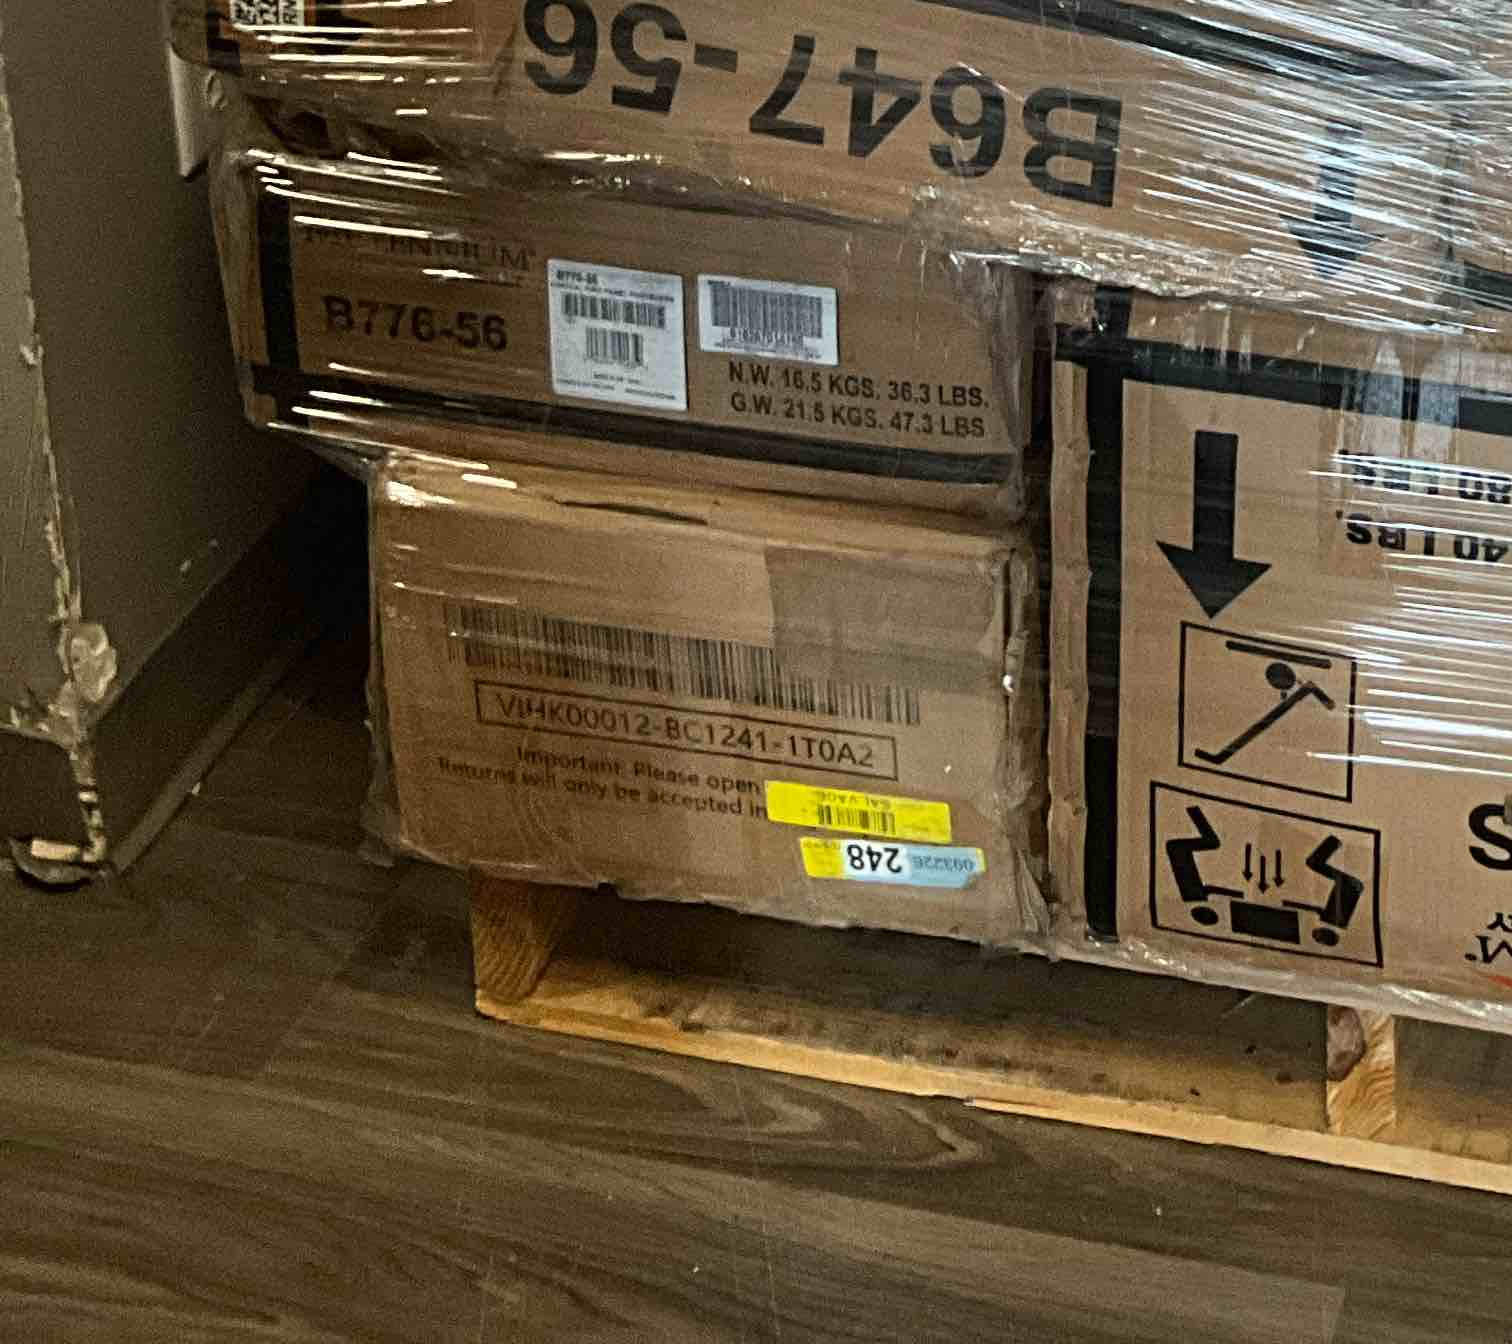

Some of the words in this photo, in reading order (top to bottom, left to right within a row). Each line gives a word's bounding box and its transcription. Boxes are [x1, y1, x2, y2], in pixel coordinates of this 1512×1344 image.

[322, 294, 509, 352] B776-56
[728, 360, 776, 388] N.W.
[828, 371, 881, 401] KGS.
[888, 379, 932, 406] 36.3
[936, 383, 989, 410] LBS.
[729, 393, 779, 419] G.W.
[783, 397, 826, 424] 21.5
[831, 403, 883, 430] KGS.
[889, 410, 934, 435] 47.3
[564, 777, 608, 801] only
[615, 781, 641, 801] be
[648, 787, 742, 815] accepted
[633, 761, 699, 787] Please
[707, 774, 761, 797] open
[846, 844, 903, 875] 248
